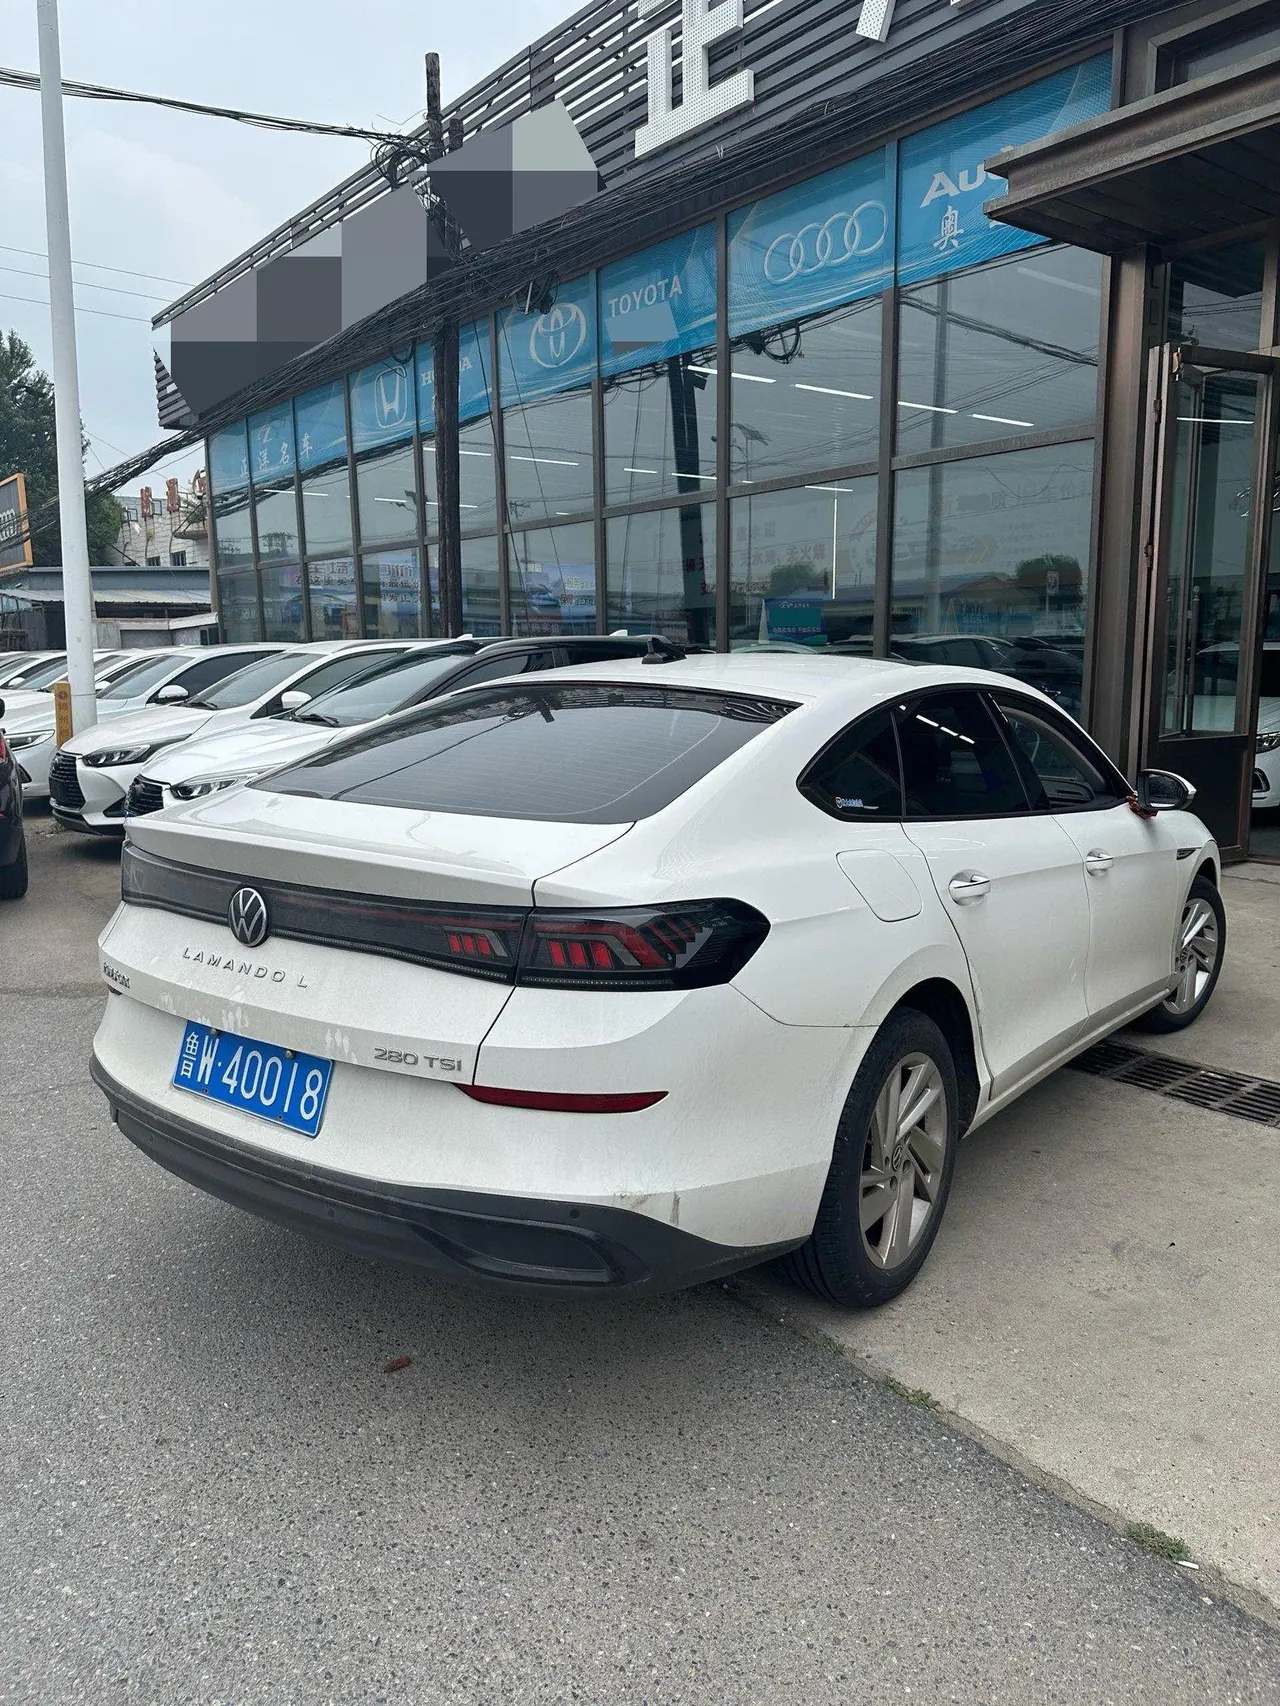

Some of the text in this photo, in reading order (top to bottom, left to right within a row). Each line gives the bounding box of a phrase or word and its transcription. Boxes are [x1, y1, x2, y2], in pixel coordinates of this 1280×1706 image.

[608, 275, 683, 318] TOYOTA
[182, 947, 308, 989] LAMANDO L
[374, 1046, 419, 1066] 280
